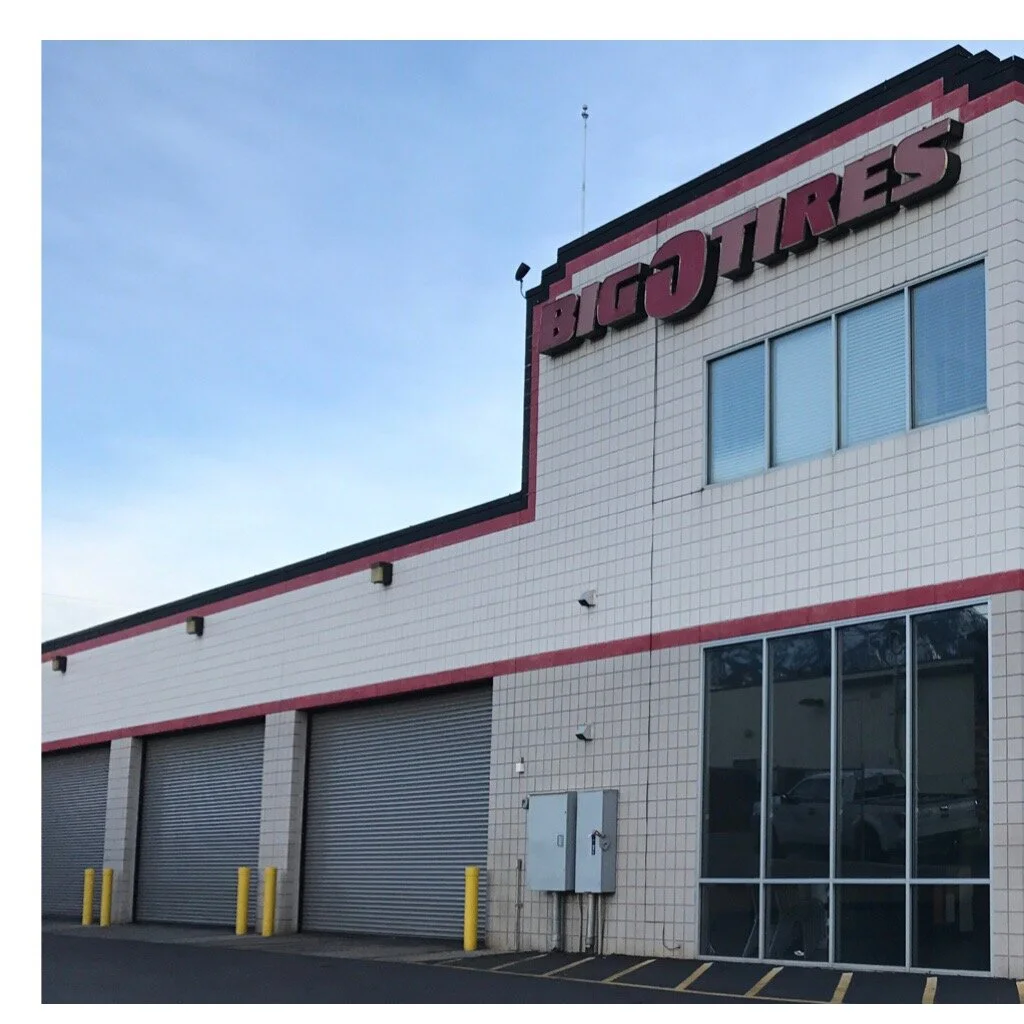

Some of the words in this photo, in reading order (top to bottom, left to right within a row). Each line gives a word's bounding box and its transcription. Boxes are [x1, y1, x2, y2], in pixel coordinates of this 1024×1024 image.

[539, 262, 649, 356] BIG
[644, 229, 718, 323] O
[711, 118, 965, 282] TIRES
